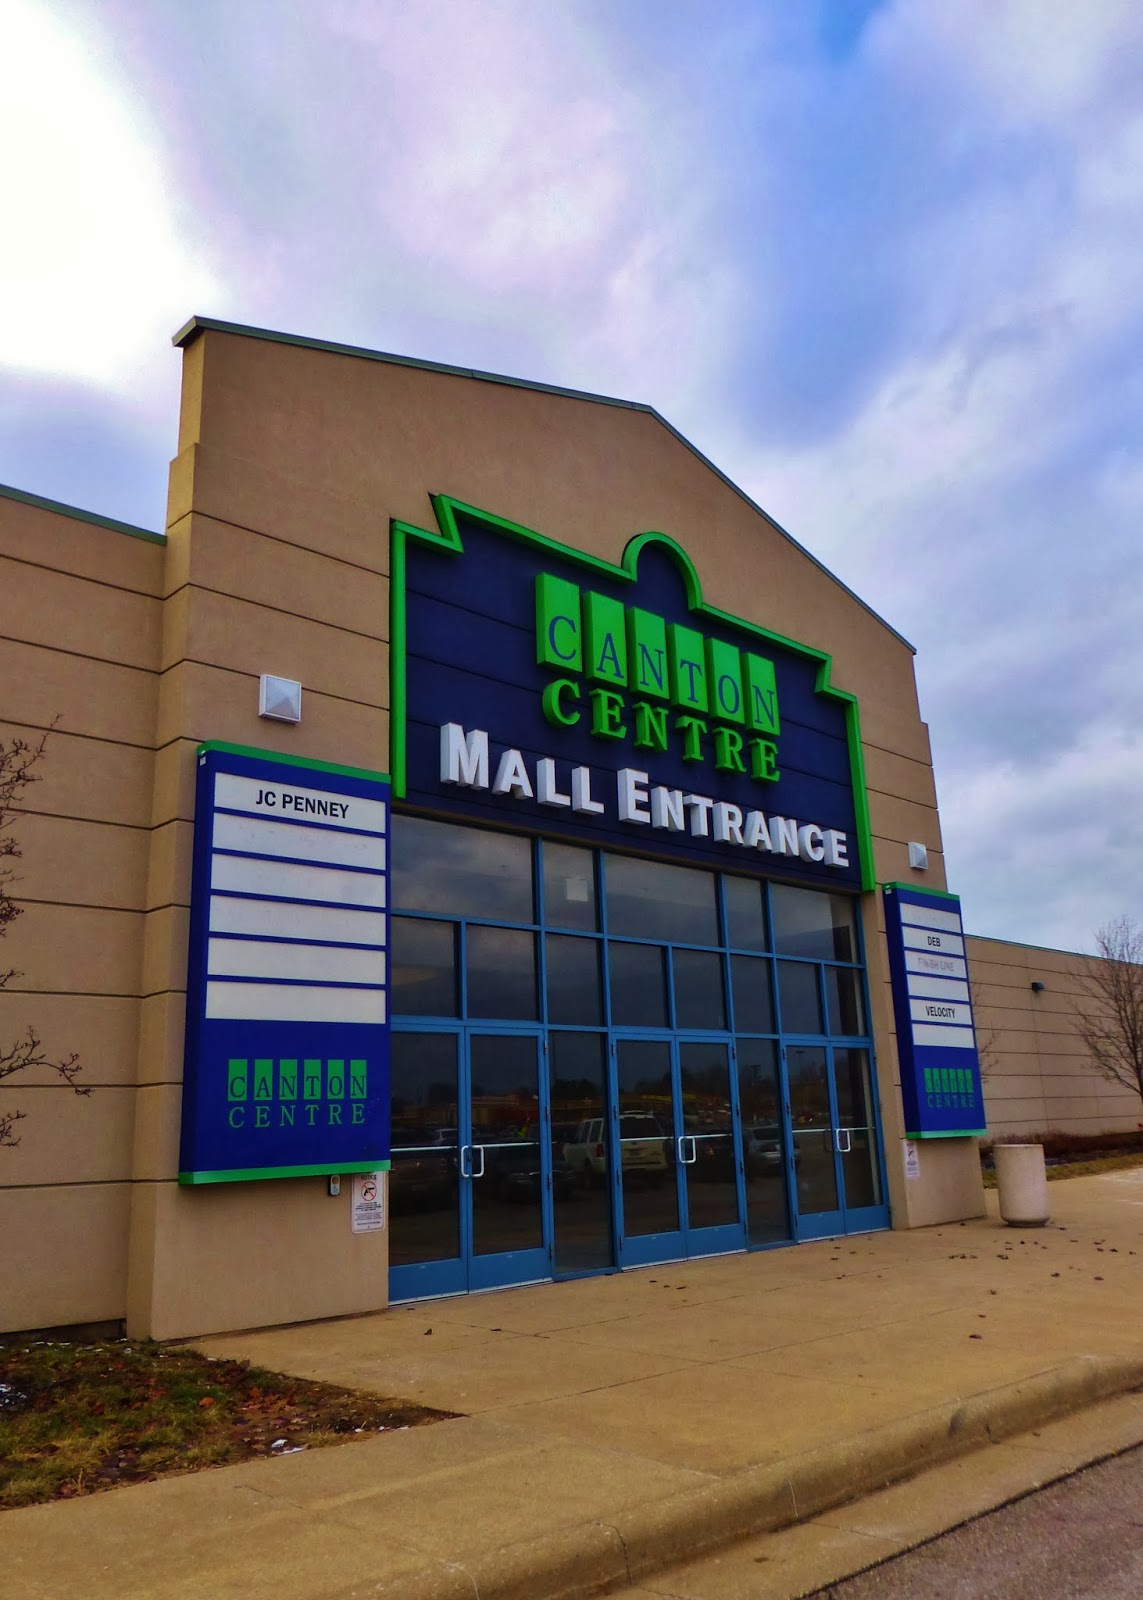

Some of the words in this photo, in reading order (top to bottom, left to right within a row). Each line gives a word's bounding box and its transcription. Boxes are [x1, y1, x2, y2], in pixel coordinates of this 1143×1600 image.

[547, 613, 775, 729] CANTON
[542, 678, 780, 783] CENTRE
[256, 789, 277, 807] JC
[282, 793, 349, 819] PENNEY
[440, 722, 605, 815] MALL
[617, 767, 850, 868] ENTRANCE
[927, 936, 941, 947] DEB
[925, 1006, 956, 1018] VELOCITY
[229, 1074, 367, 1099] CANTON
[927, 1095, 975, 1108] CENTRE
[228, 1103, 366, 1128] CENTRE
